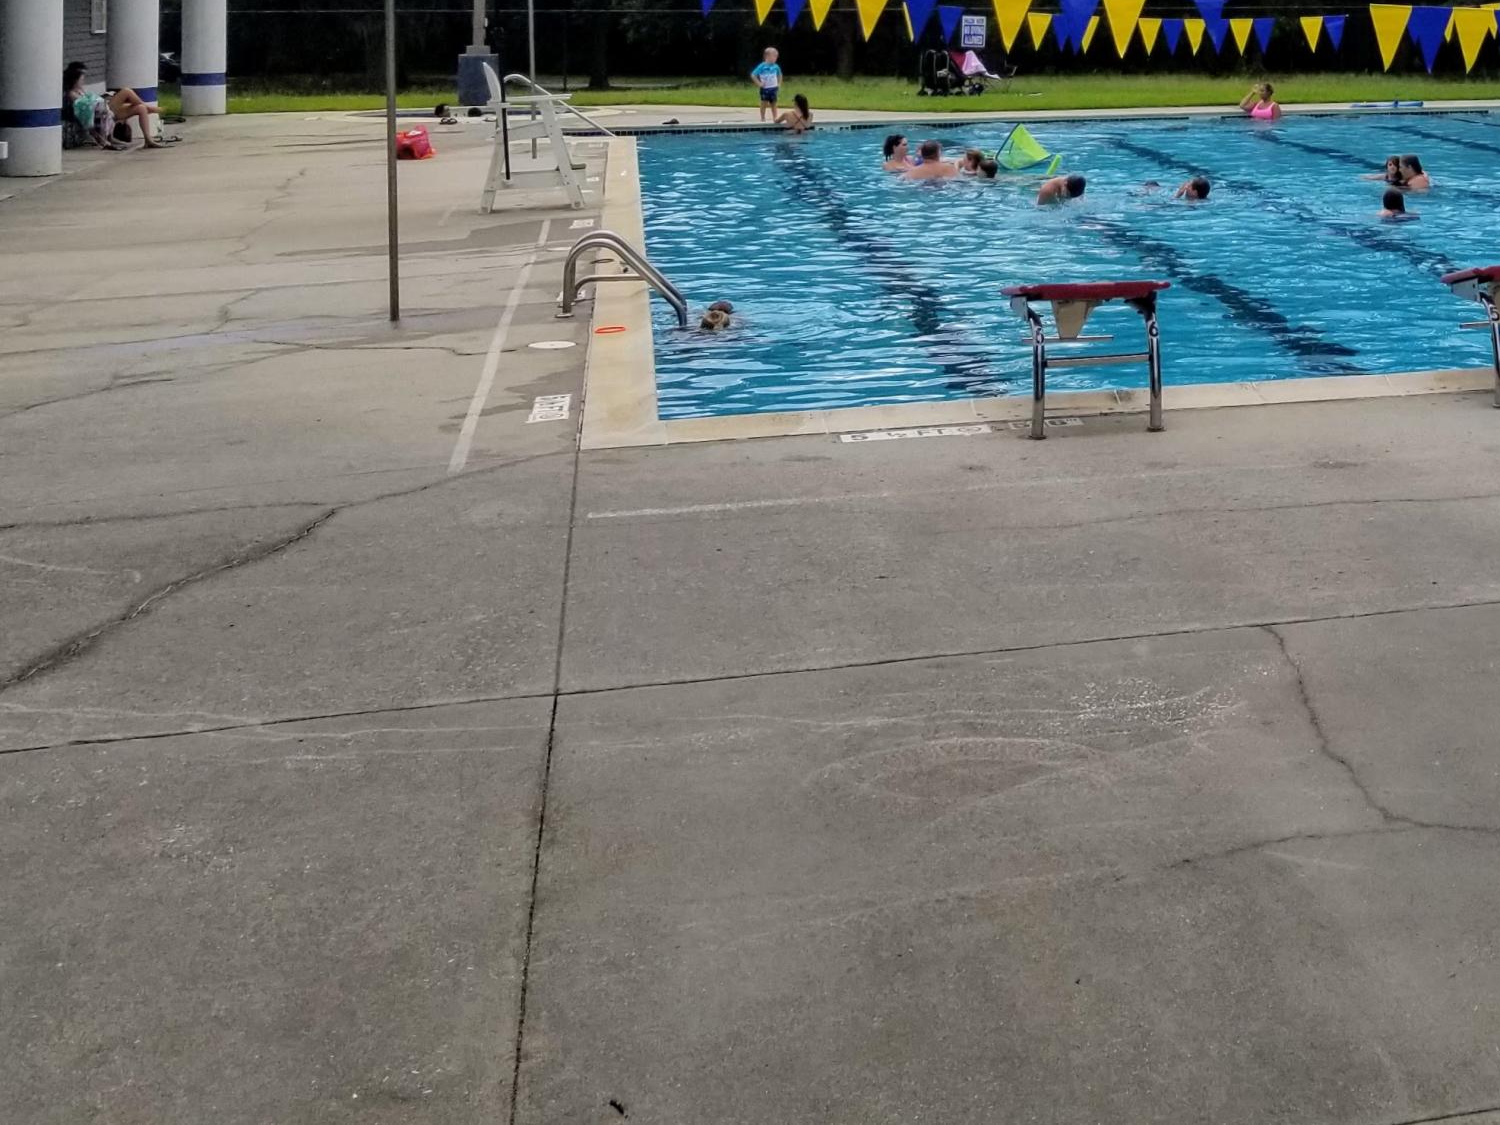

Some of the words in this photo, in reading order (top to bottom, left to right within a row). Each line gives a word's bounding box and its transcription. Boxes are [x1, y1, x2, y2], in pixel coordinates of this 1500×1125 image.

[1489, 307, 1500, 321] 5
[1148, 321, 1159, 337] 6
[916, 428, 946, 436] FT
